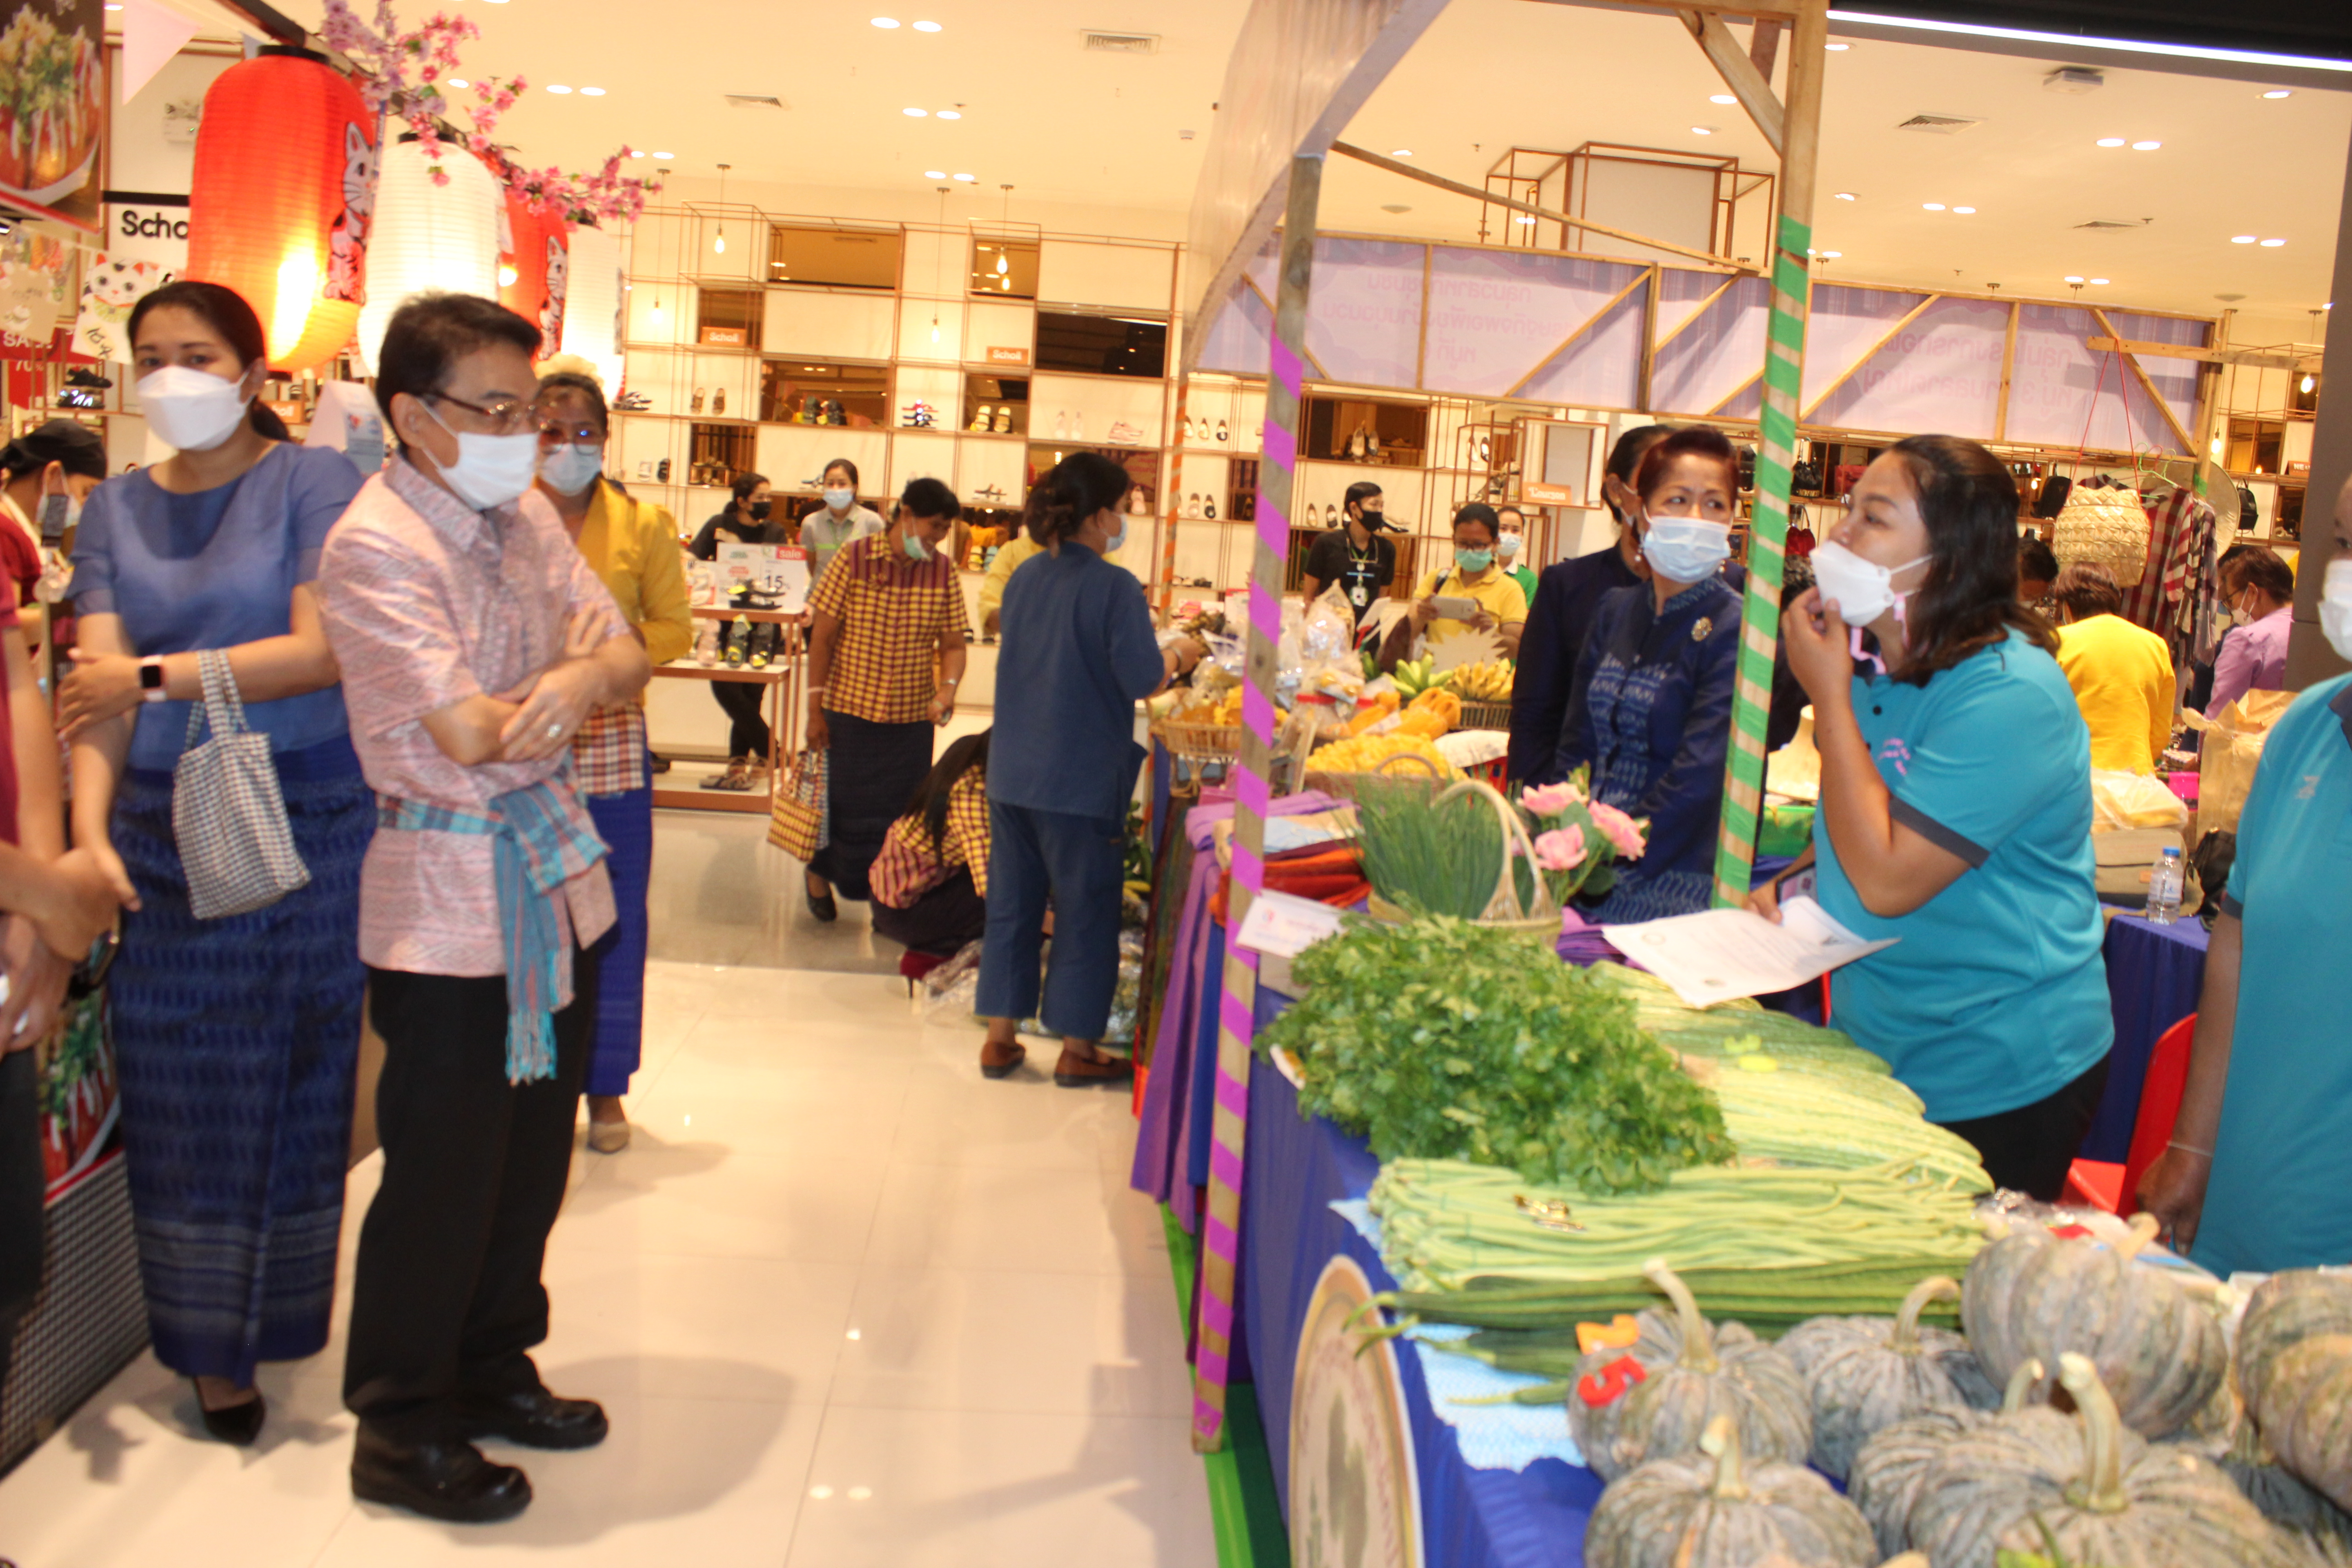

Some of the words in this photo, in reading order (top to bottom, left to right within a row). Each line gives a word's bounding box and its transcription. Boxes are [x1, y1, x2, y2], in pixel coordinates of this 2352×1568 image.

[121, 210, 188, 239] Scho
[709, 332, 738, 343] Scholl
[993, 349, 1022, 360] Scholl
[779, 549, 802, 559] sale
